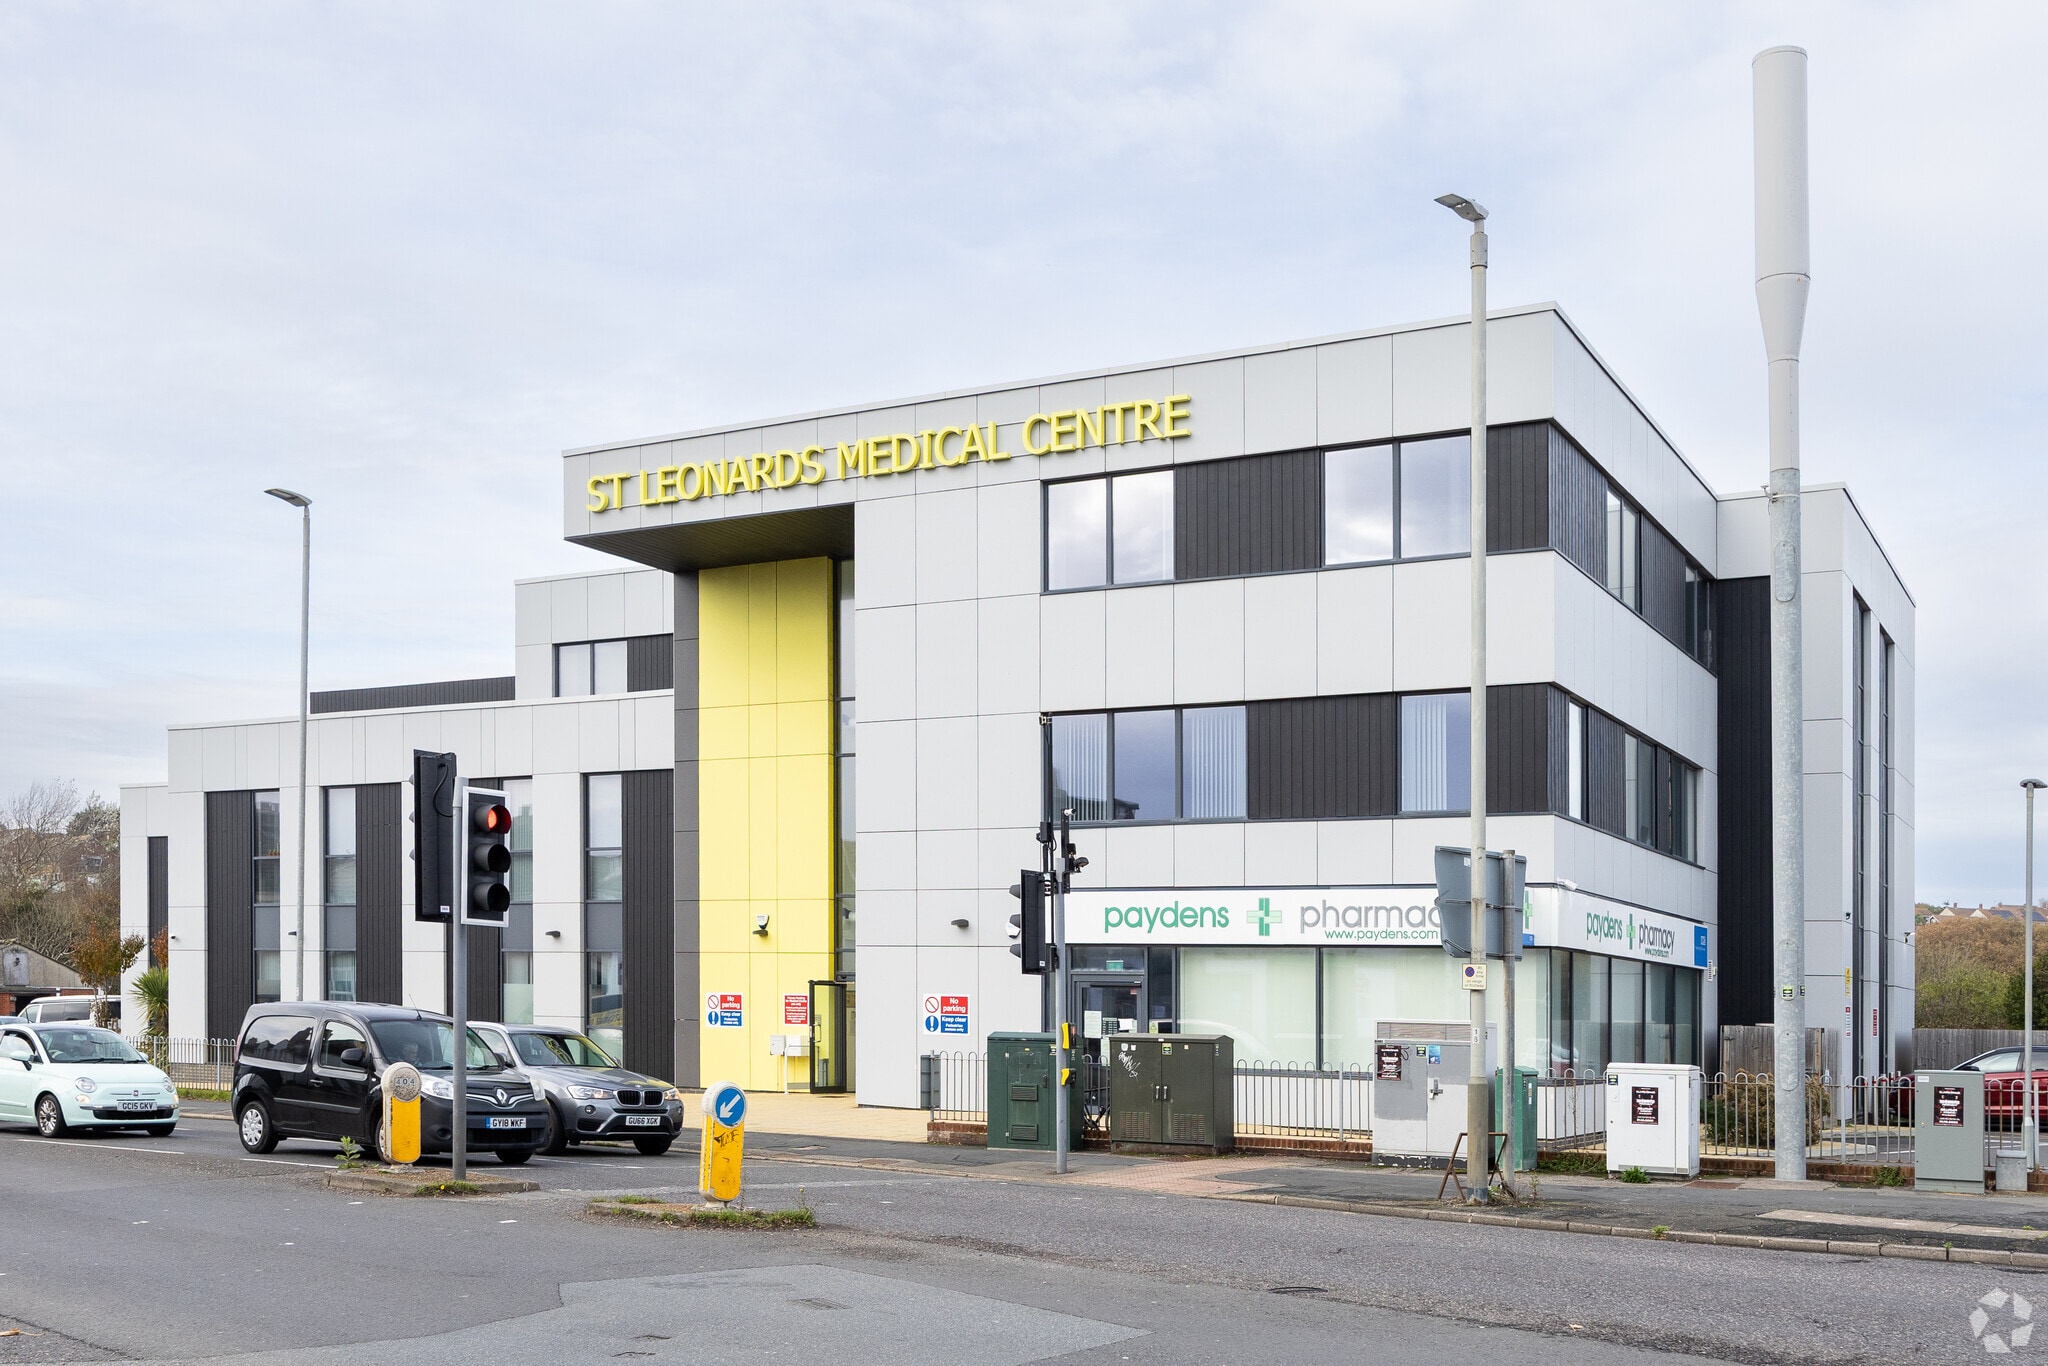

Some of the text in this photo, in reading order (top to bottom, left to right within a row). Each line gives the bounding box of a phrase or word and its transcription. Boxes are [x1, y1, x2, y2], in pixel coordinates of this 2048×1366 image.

[586, 393, 1192, 513] ST LEONARDS MEDICAL CENTRE
[1104, 899, 1441, 934] paydens pharmac
[1324, 928, 1438, 941] www.paydens.com
[1586, 910, 1676, 956] paydens pharmacy
[942, 1005, 966, 1013] parking
[492, 1118, 524, 1127] GY18 WKF
